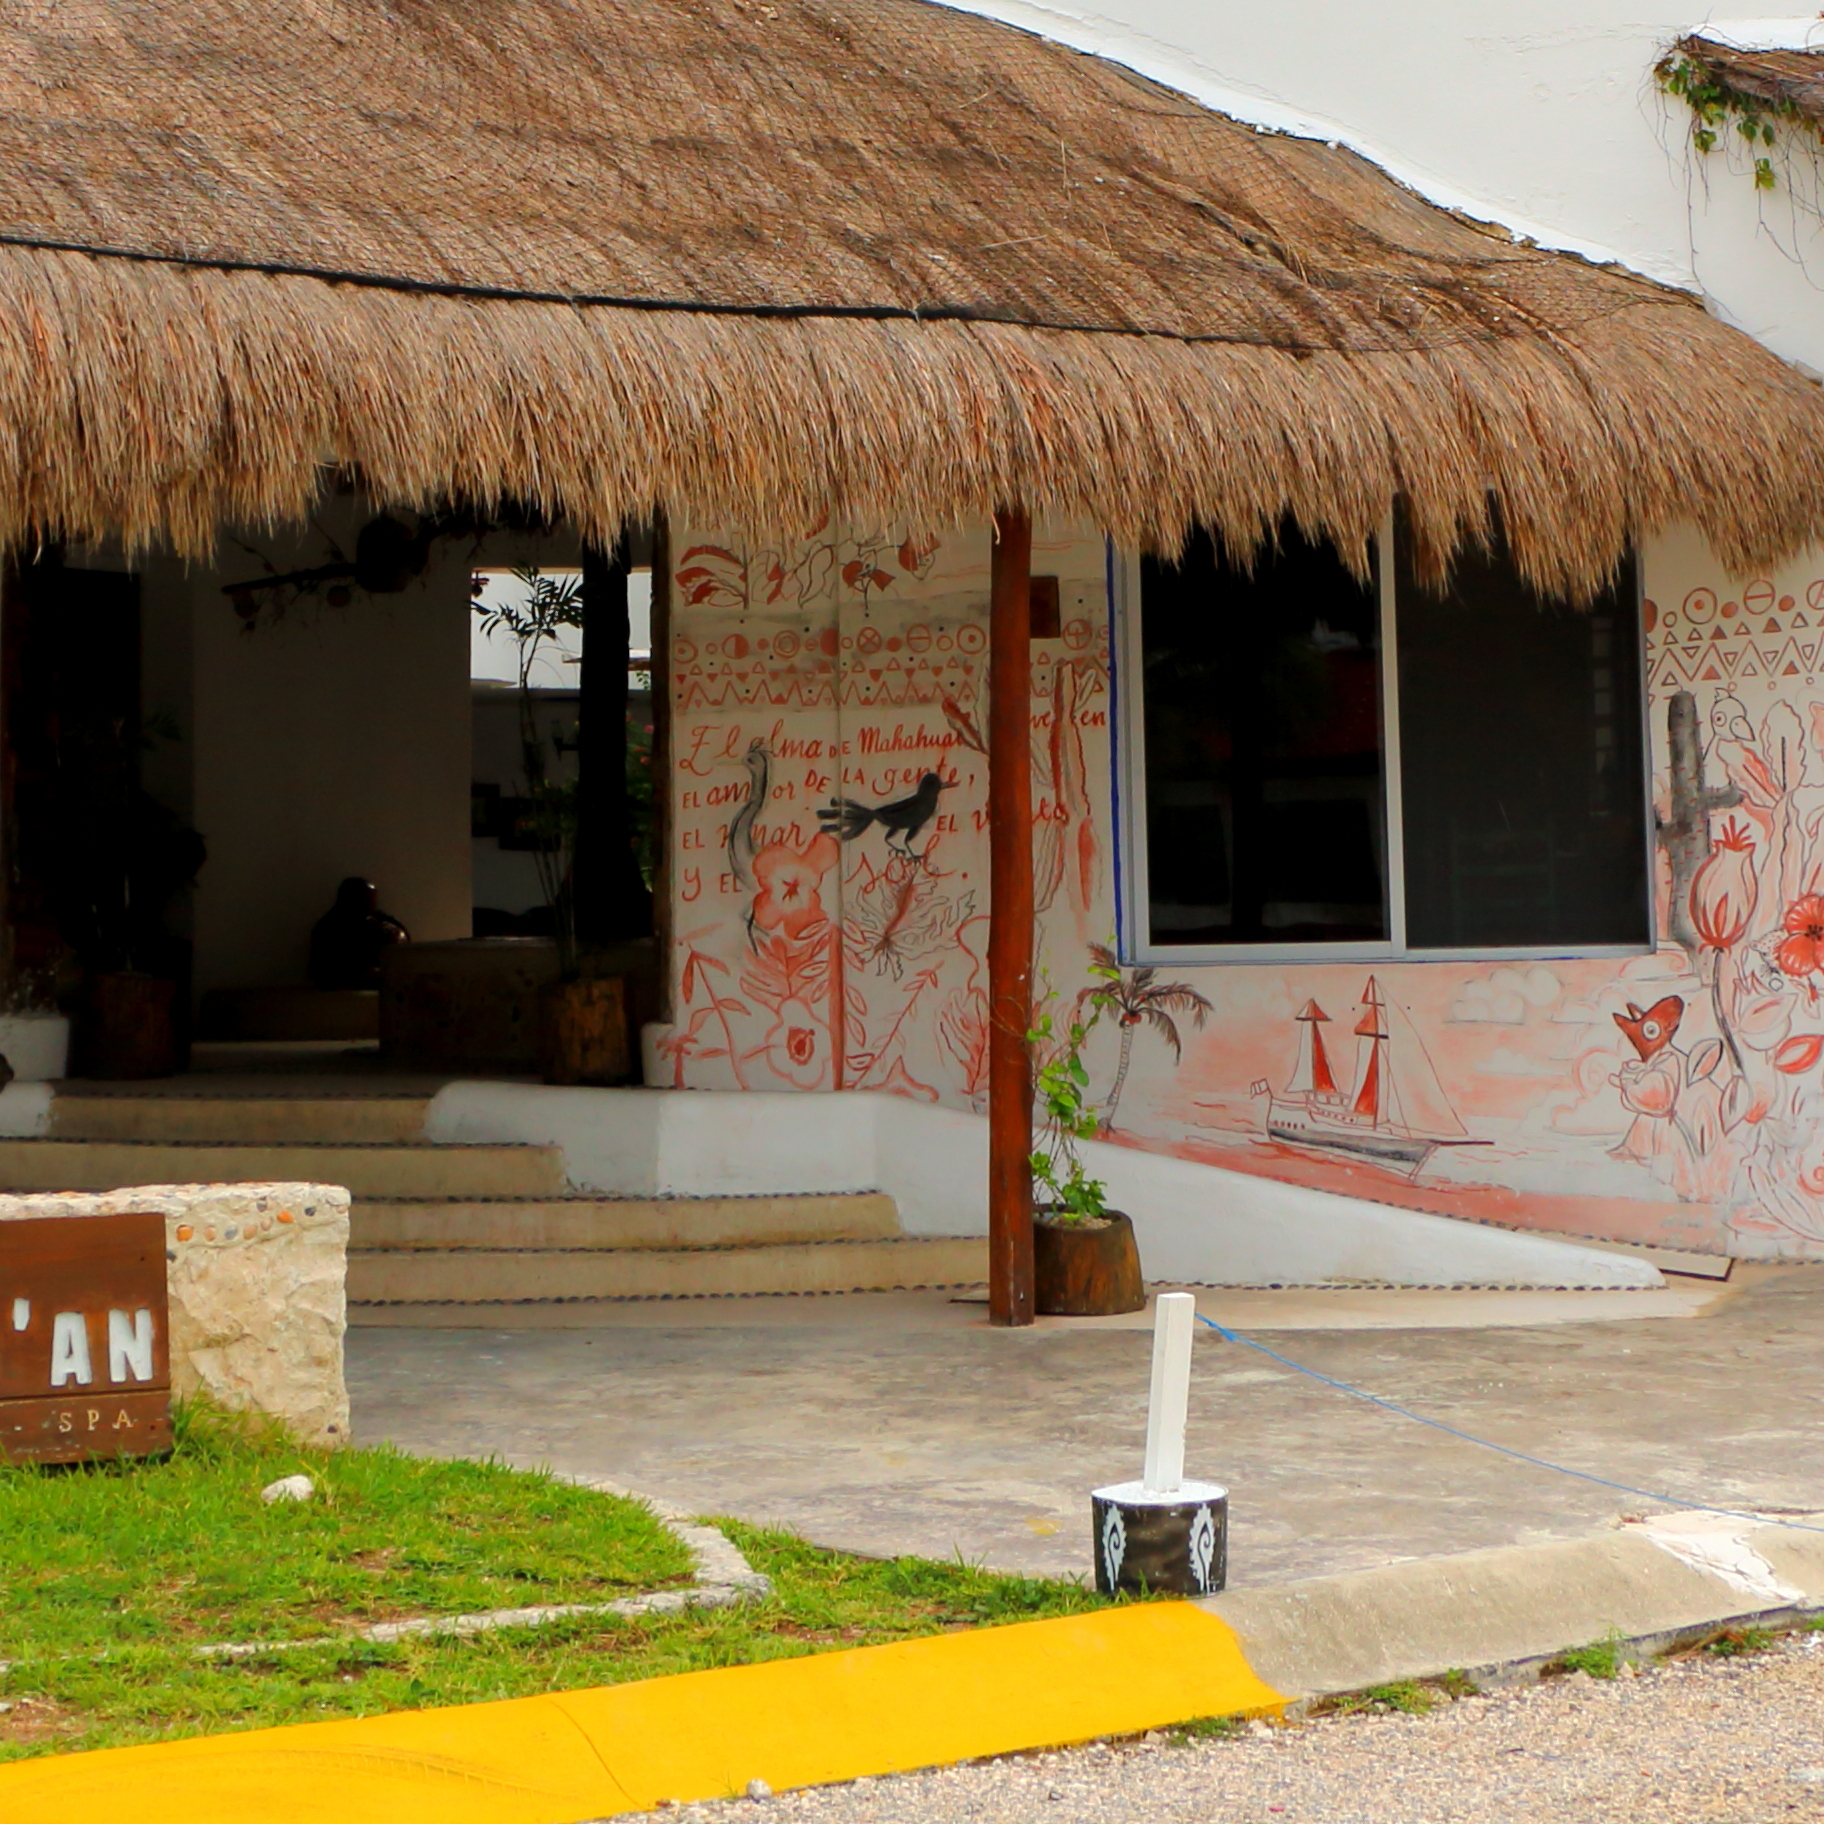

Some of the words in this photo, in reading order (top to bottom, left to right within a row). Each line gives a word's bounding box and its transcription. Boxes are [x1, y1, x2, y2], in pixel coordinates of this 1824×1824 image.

[828, 740, 852, 759] DE
[1080, 709, 1106, 727] en
[682, 790, 701, 810] EL
[804, 768, 832, 794] DE
[842, 766, 865, 786] LA
[682, 828, 706, 850] EL
[935, 813, 959, 833] EL
[719, 872, 743, 894] EL
[58, 1409, 134, 1434] SPA
